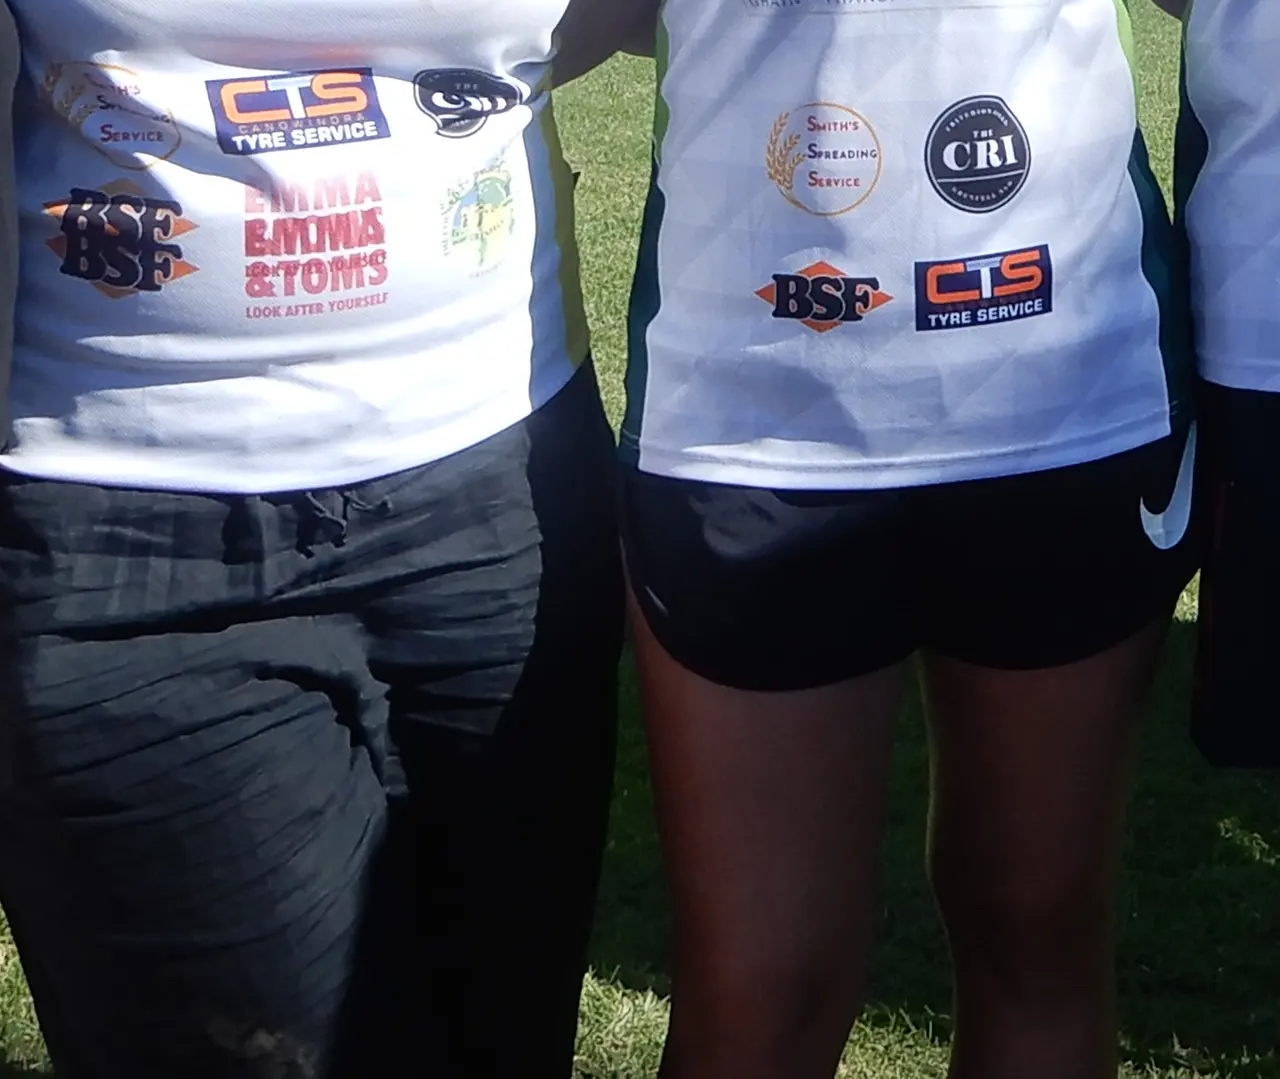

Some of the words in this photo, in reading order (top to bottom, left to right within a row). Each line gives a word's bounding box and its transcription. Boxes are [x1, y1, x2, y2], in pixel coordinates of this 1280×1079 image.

[220, 72, 368, 124] CTS
[231, 131, 287, 151] TYRE
[291, 121, 379, 145] SERVICE
[942, 134, 1019, 171] CRI
[245, 170, 383, 214] EMMA
[926, 249, 1043, 304] CTS
[245, 305, 281, 319] LOOK
[285, 302, 325, 317] AFTER
[328, 292, 389, 312] YOURSELF
[771, 272, 880, 322] BSF
[928, 310, 972, 327] TYRE
[977, 298, 1044, 322] SERVICE
